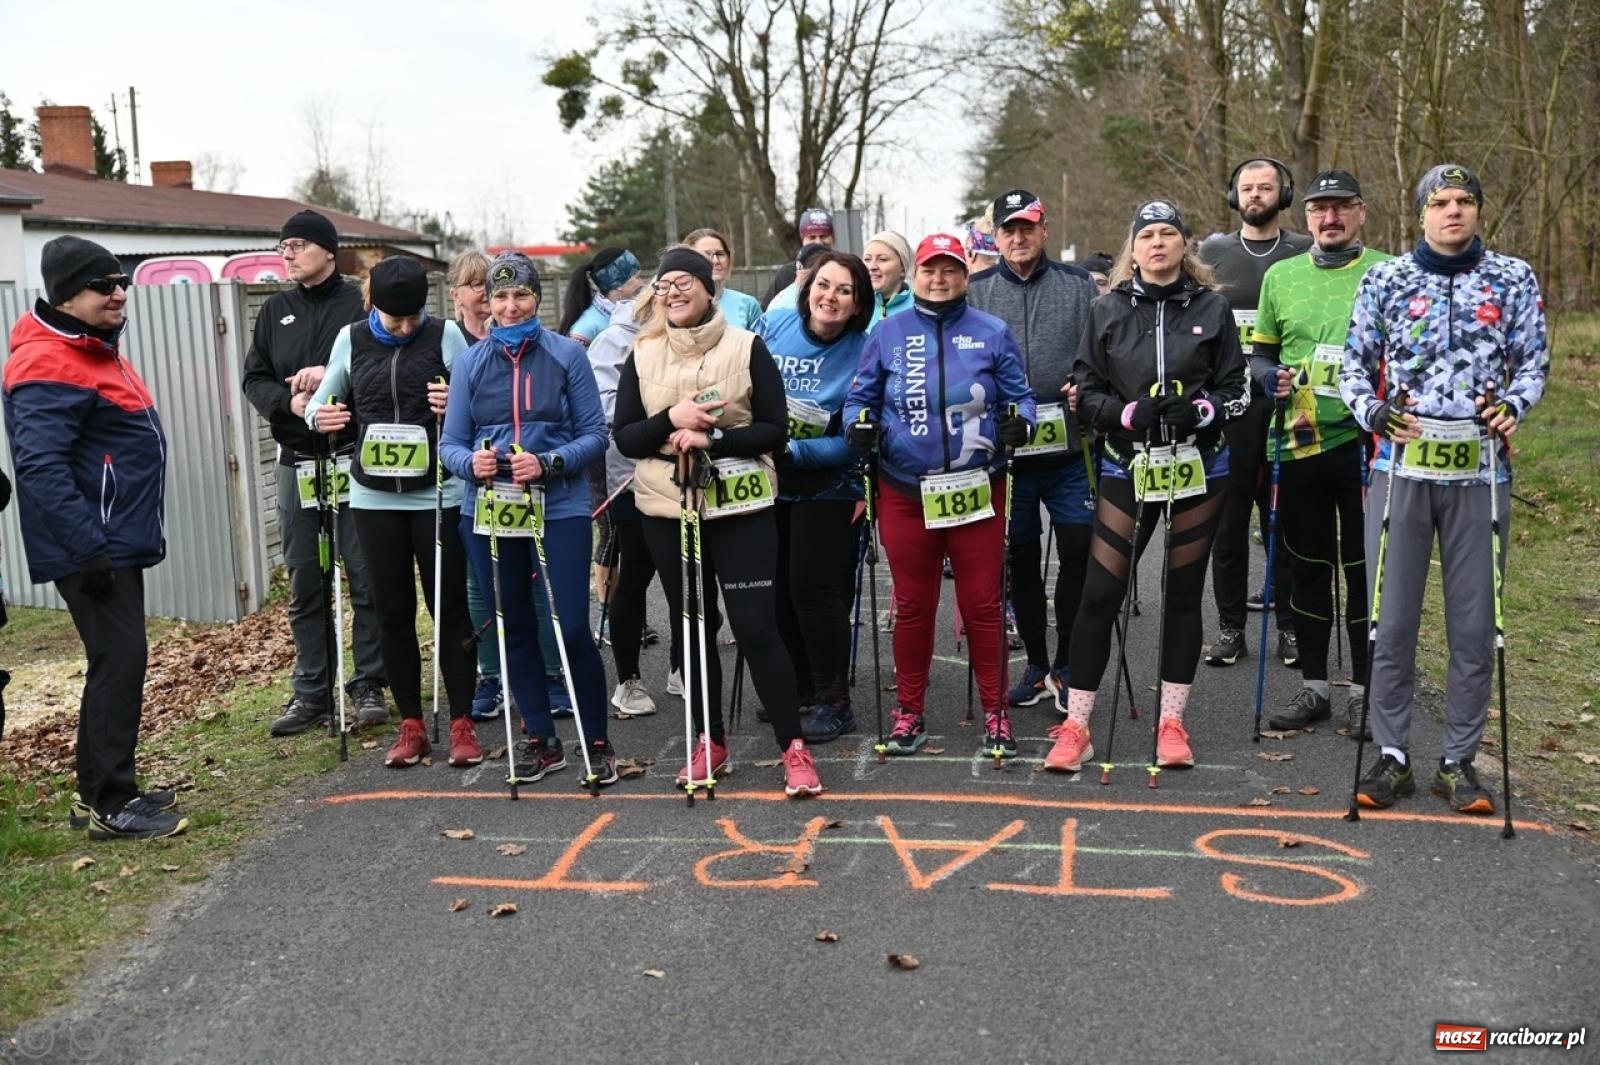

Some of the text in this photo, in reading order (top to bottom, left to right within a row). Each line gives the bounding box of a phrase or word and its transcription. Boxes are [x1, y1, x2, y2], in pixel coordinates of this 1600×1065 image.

[905, 334, 929, 436] RUNNERS
[894, 396, 906, 423] TEAM
[370, 443, 418, 466] 157
[1415, 441, 1470, 469] 158
[934, 488, 982, 518] 181
[431, 811, 1370, 905] START
